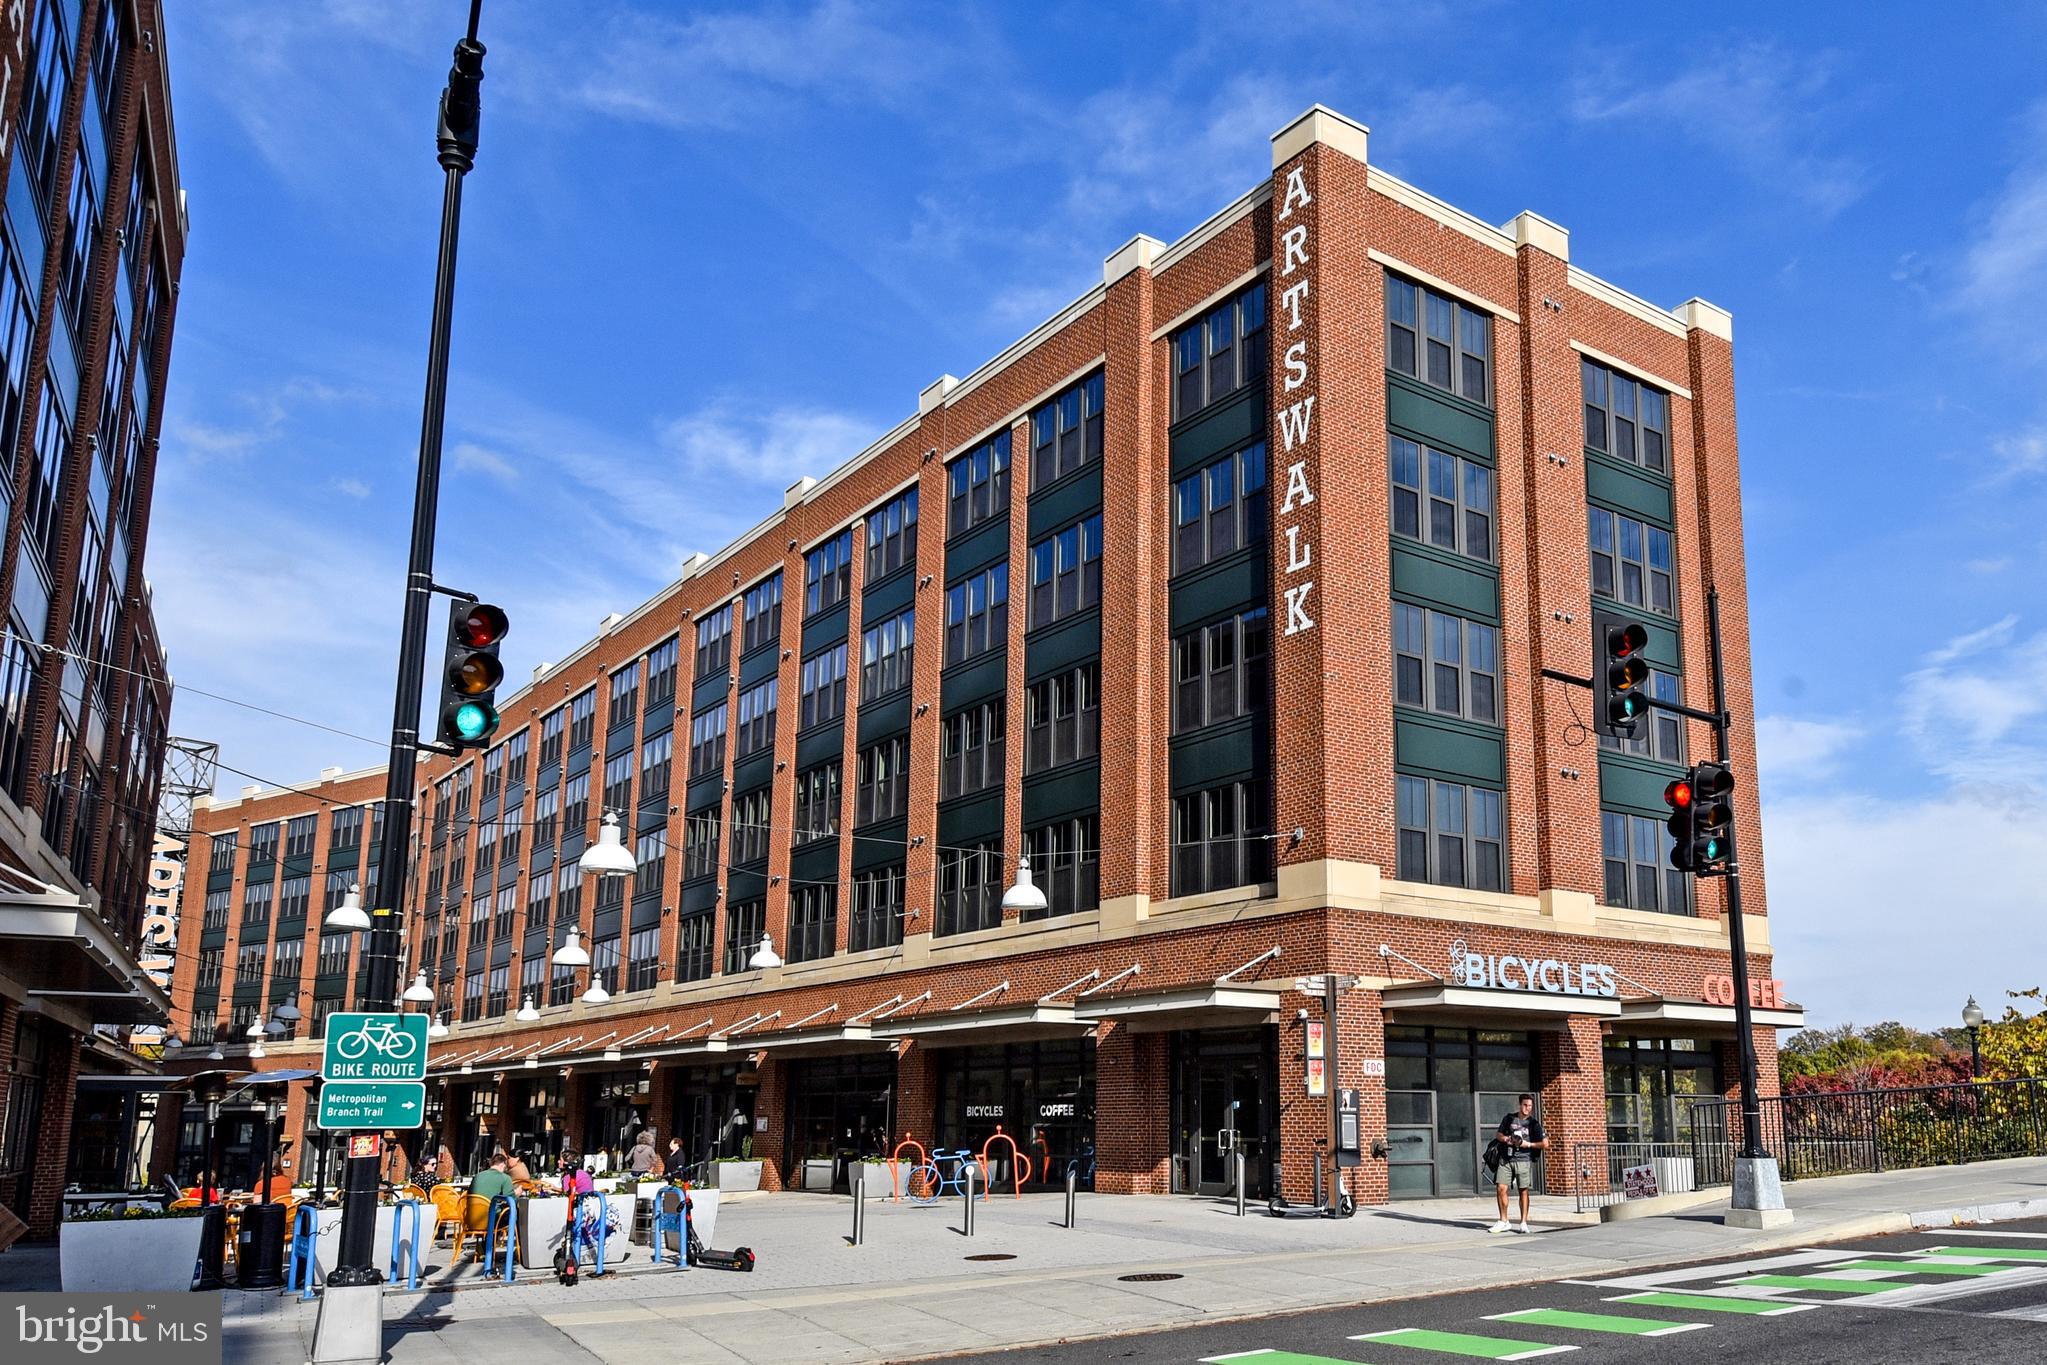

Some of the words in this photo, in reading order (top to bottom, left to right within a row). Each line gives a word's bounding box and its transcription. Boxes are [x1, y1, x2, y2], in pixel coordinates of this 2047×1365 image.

[1466, 953, 1617, 997] BICYCLES
[1703, 974, 1787, 1009] COFEE
[332, 1063, 364, 1077] BIKE
[371, 1063, 416, 1077] ROUTE
[1366, 1062, 1382, 1073] FDC
[328, 1093, 387, 1105] Metropolitan
[326, 1106, 360, 1117] Branch
[363, 1106, 383, 1117] Trail
[966, 1105, 1004, 1117] BICYCLES
[1040, 1104, 1075, 1117] COFFEE
